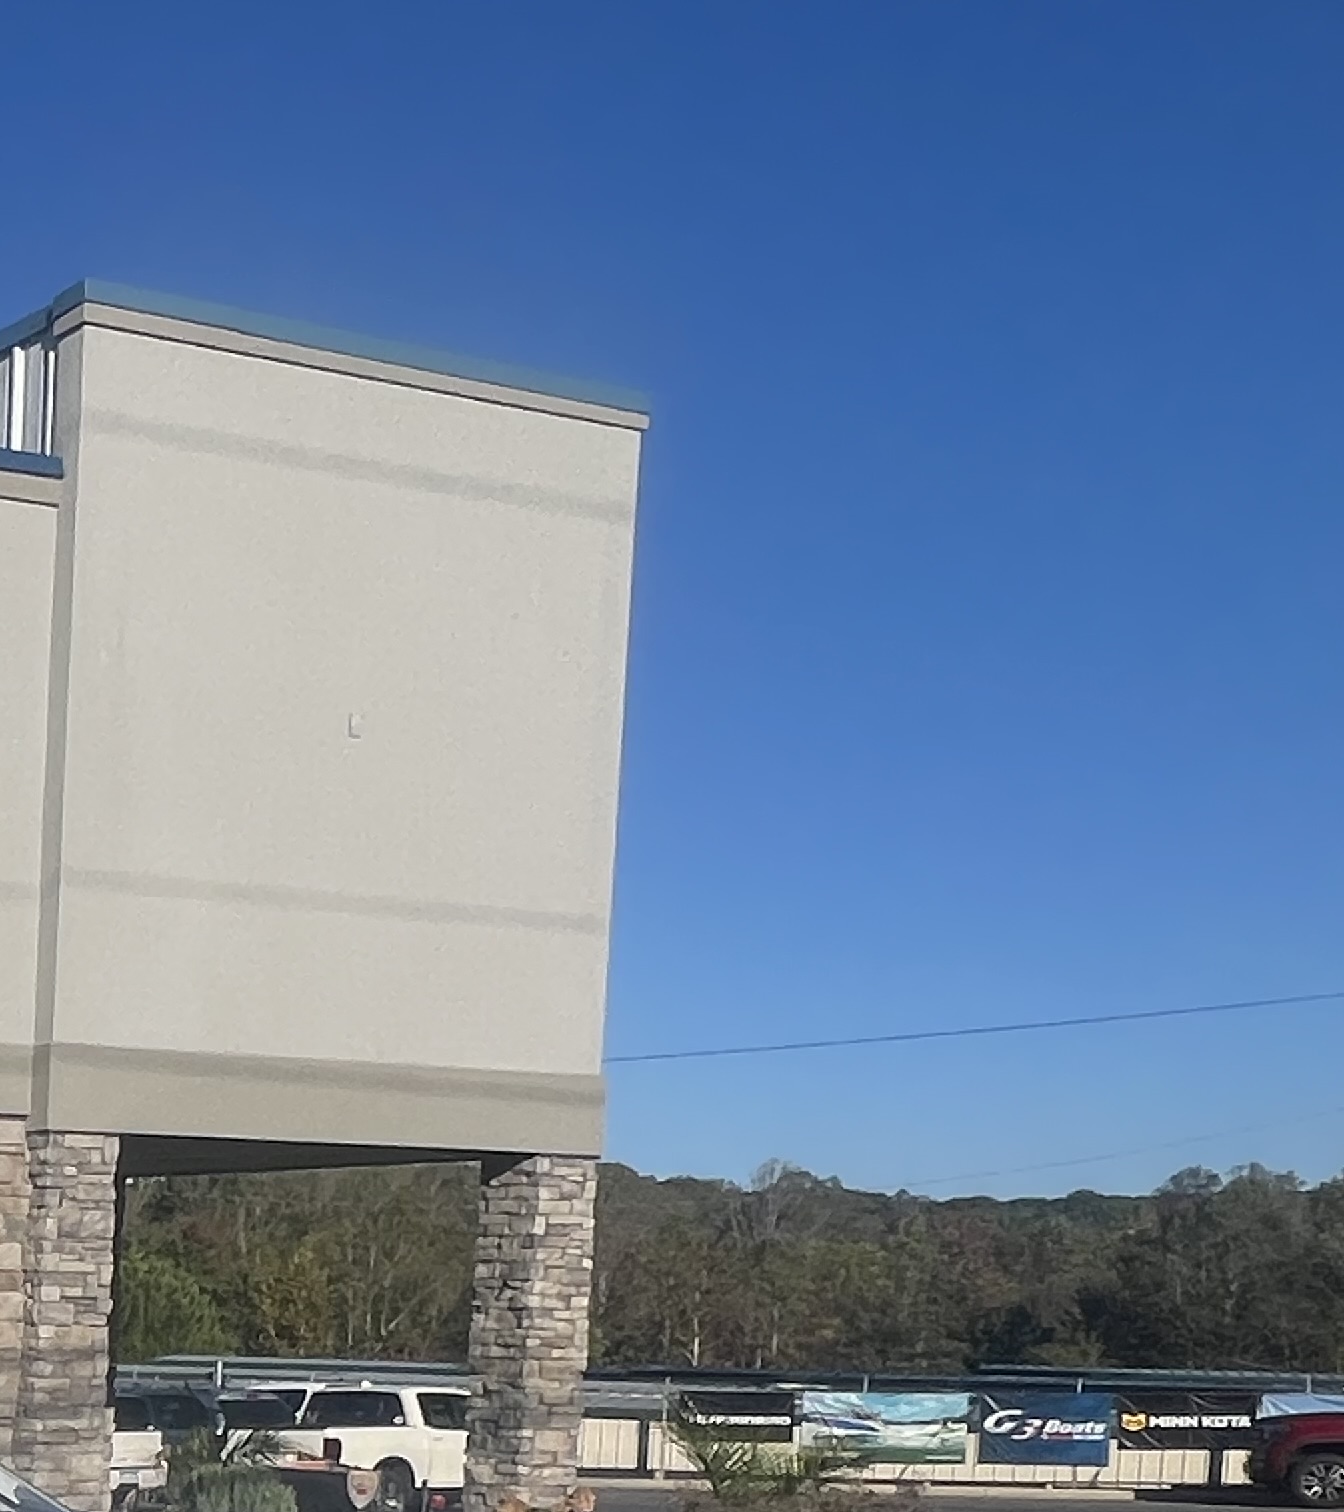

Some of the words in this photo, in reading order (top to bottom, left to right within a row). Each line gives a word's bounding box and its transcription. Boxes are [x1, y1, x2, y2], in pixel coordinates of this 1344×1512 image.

[983, 1408, 1044, 1440] G3
[1043, 1419, 1108, 1434] Boats
[1148, 1415, 1199, 1428] MINN
[1200, 1415, 1252, 1428] KOTA
